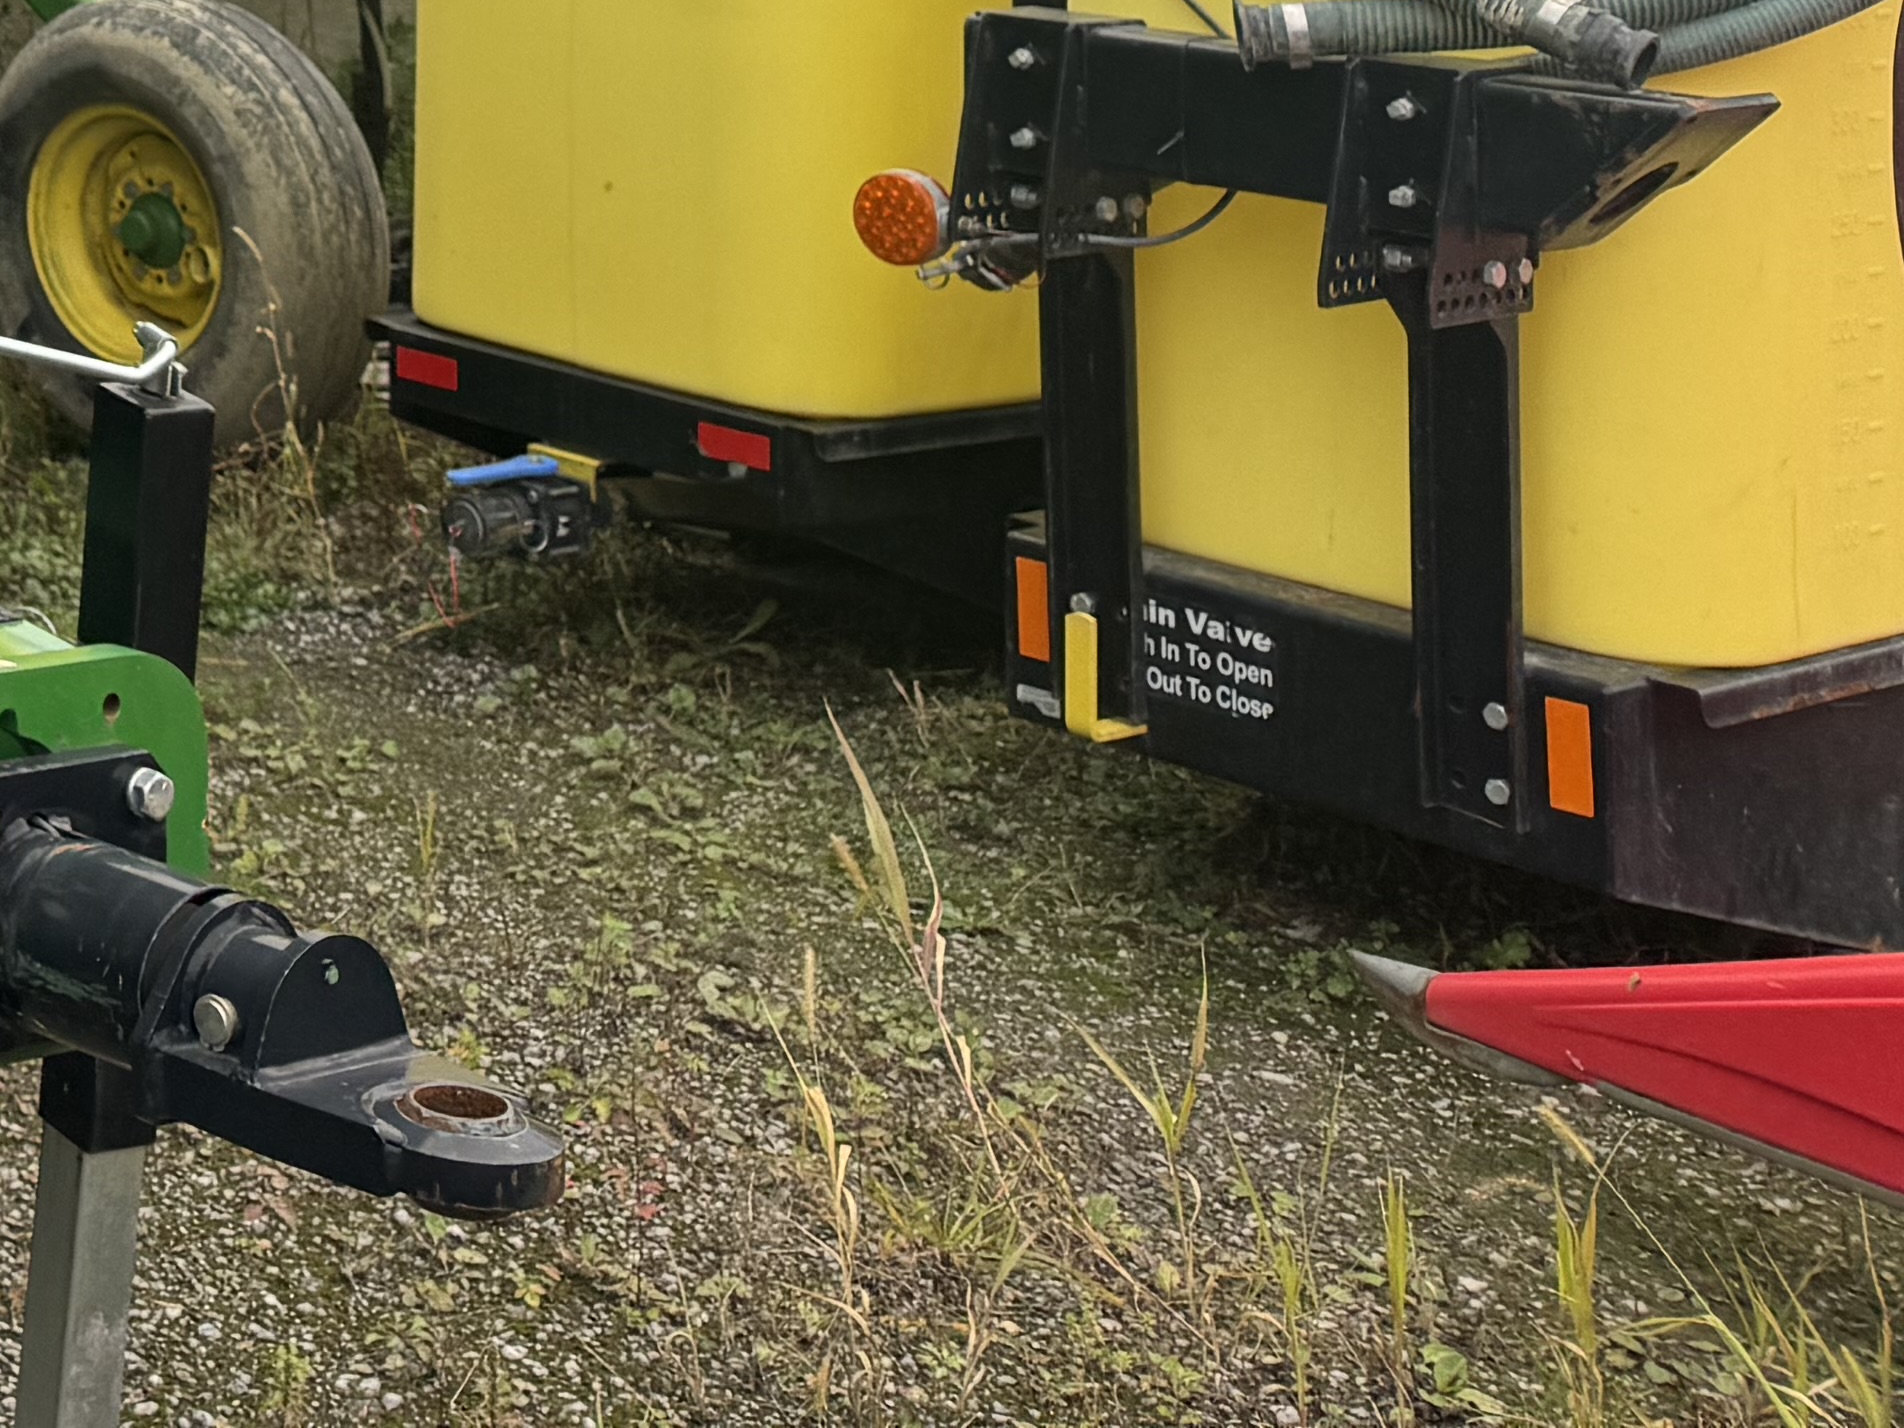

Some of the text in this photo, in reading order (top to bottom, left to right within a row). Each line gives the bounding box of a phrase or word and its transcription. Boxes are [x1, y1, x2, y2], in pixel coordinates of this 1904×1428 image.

[1161, 636, 1180, 662] In
[1184, 642, 1211, 670] To
[1217, 652, 1272, 688] Open
[1147, 666, 1182, 696] Out
[1186, 676, 1211, 703] To
